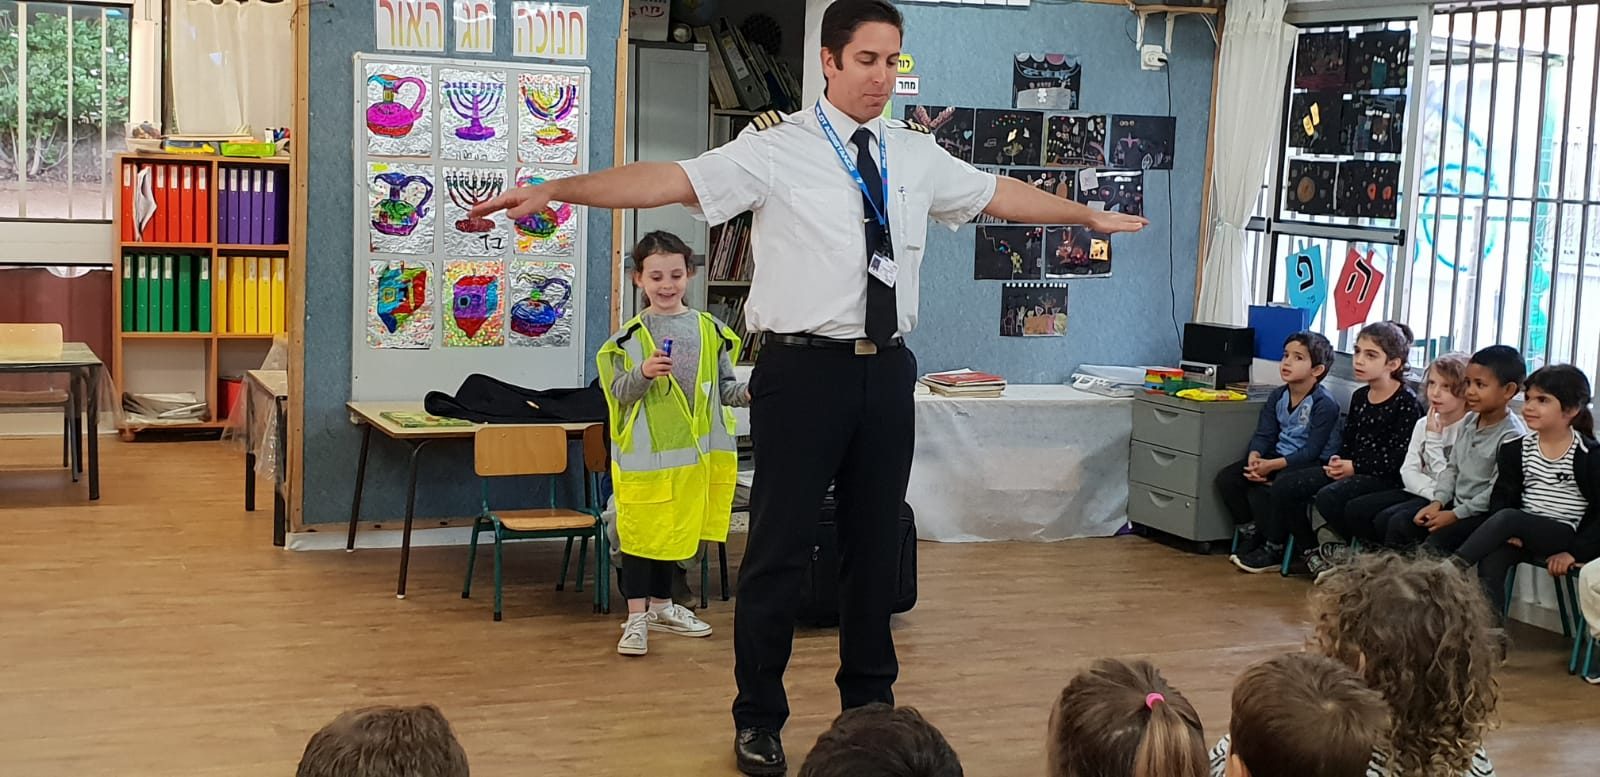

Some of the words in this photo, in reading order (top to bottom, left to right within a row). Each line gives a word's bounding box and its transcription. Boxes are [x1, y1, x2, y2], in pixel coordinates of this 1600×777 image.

[379, 0, 443, 48] האור
[460, 2, 491, 49] חג
[517, 8, 584, 55] חנוכה
[898, 80, 916, 90] מחר
[1296, 255, 1314, 292] פ
[1346, 258, 1372, 302] ה
